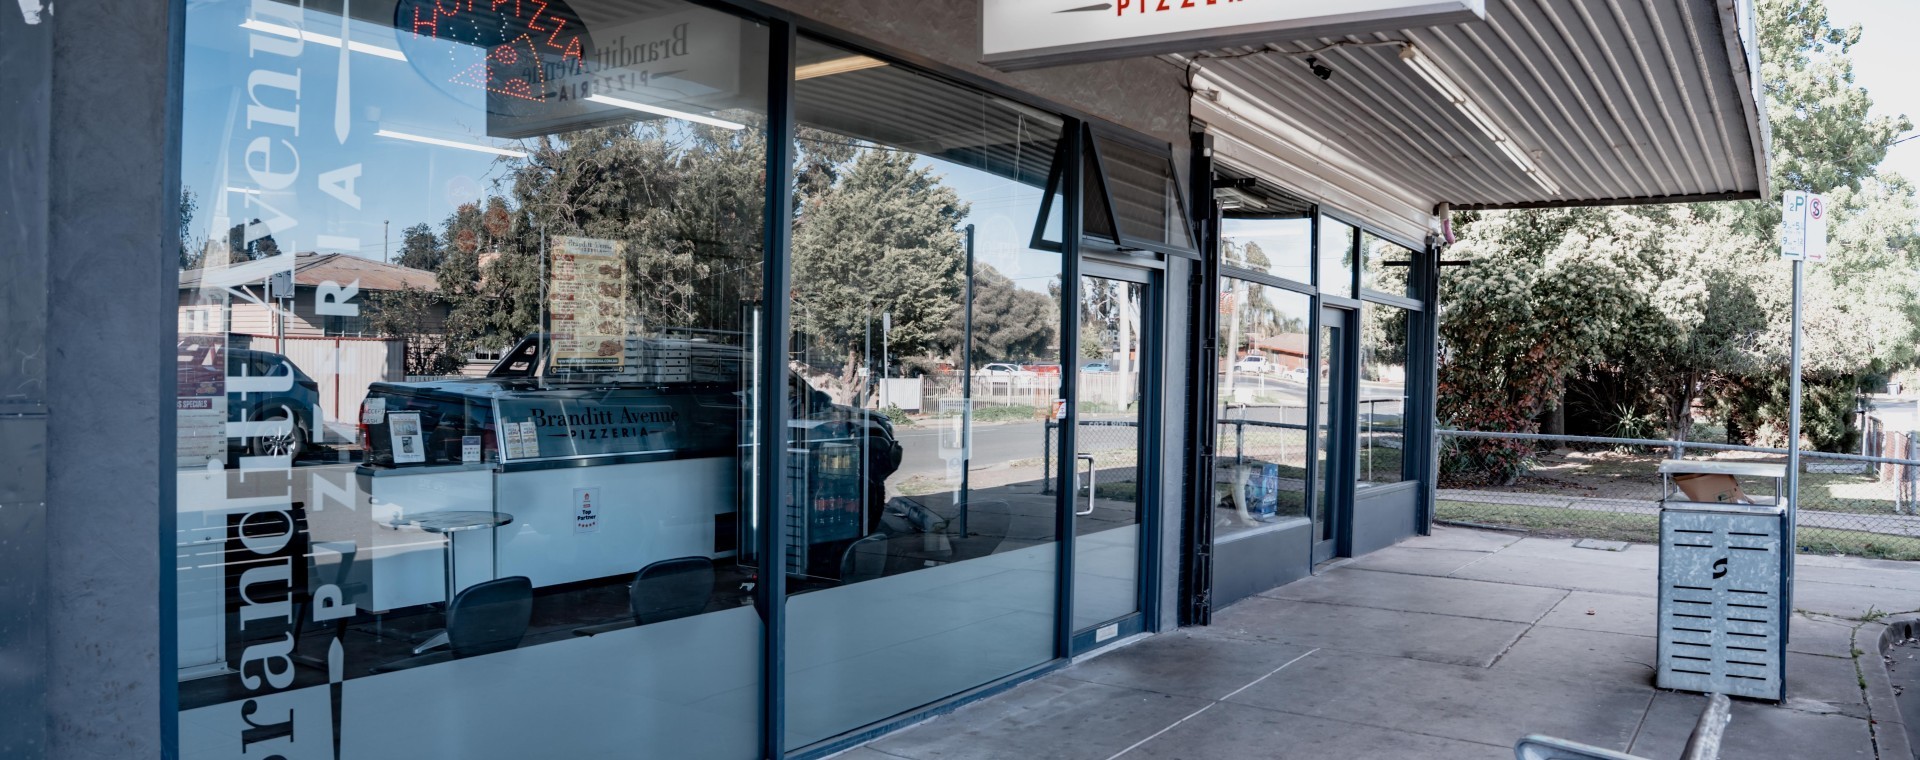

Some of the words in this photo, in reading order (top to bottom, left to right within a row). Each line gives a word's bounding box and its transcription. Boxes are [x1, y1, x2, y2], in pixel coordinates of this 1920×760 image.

[1099, 329, 1121, 343] OPE
[183, 400, 208, 409] SPECIALS
[530, 406, 614, 428] Branditt
[620, 405, 680, 425] Avenue
[571, 427, 648, 440] PIZZERIA
[204, 361, 295, 760] randitt
